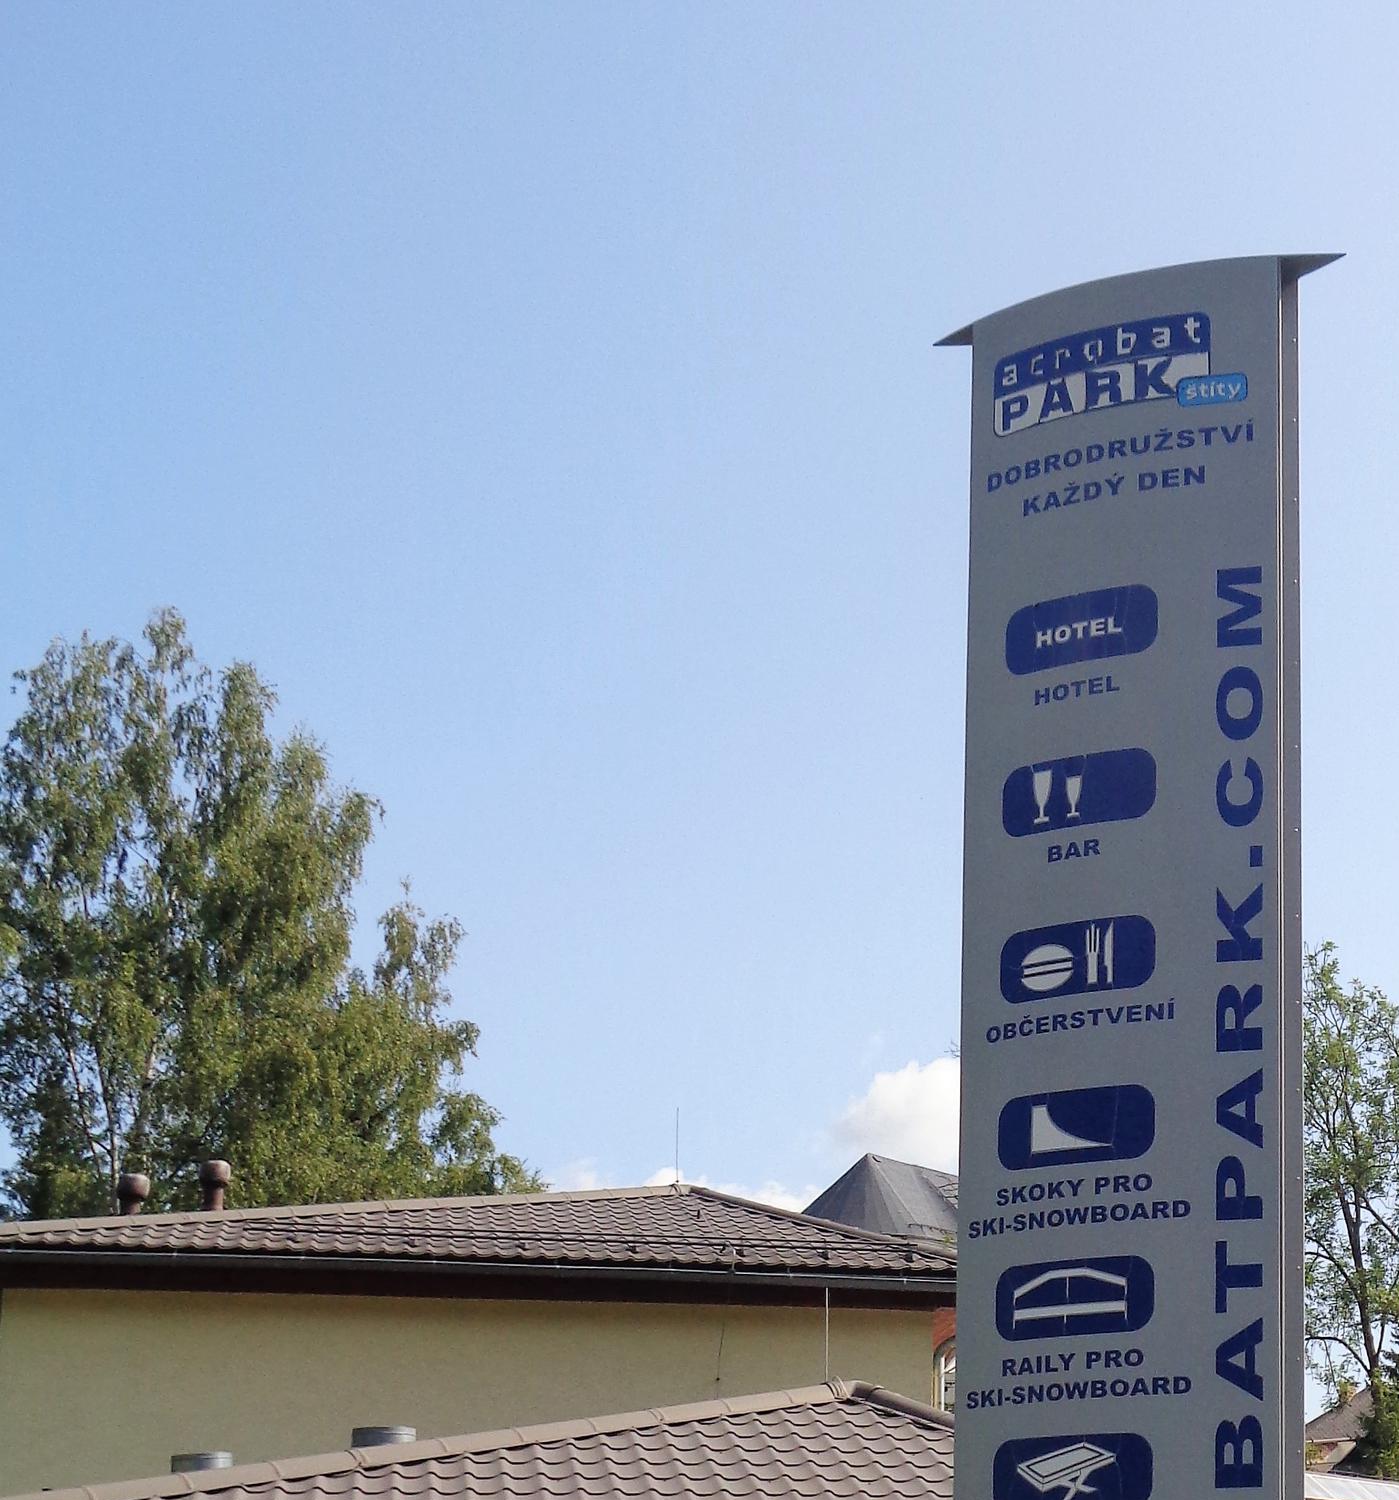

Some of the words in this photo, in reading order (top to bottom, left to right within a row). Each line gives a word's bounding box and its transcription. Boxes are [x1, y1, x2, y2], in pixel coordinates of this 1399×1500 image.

[1001, 316, 1201, 387] acrobat
[1000, 358, 1178, 433] PARK
[987, 419, 1255, 493] DOBRODRUŽSTVÍ
[1022, 473, 1125, 518] KAŽDÝ
[1137, 465, 1206, 492] DEN
[1035, 616, 1122, 649] HOTEL
[1033, 676, 1121, 706] HOTEL
[1047, 839, 1101, 864] BAR
[985, 998, 1176, 1044] OBČERSTVENÍ
[996, 1178, 1085, 1207] SKOKY
[1093, 1173, 1153, 1195] PRO
[968, 1199, 1192, 1240] SKI-SNOWBOARD
[1001, 1352, 1075, 1377] RAILY
[1085, 1348, 1145, 1369] PRO
[966, 1376, 1192, 1410] SKI-SNOWBOARD
